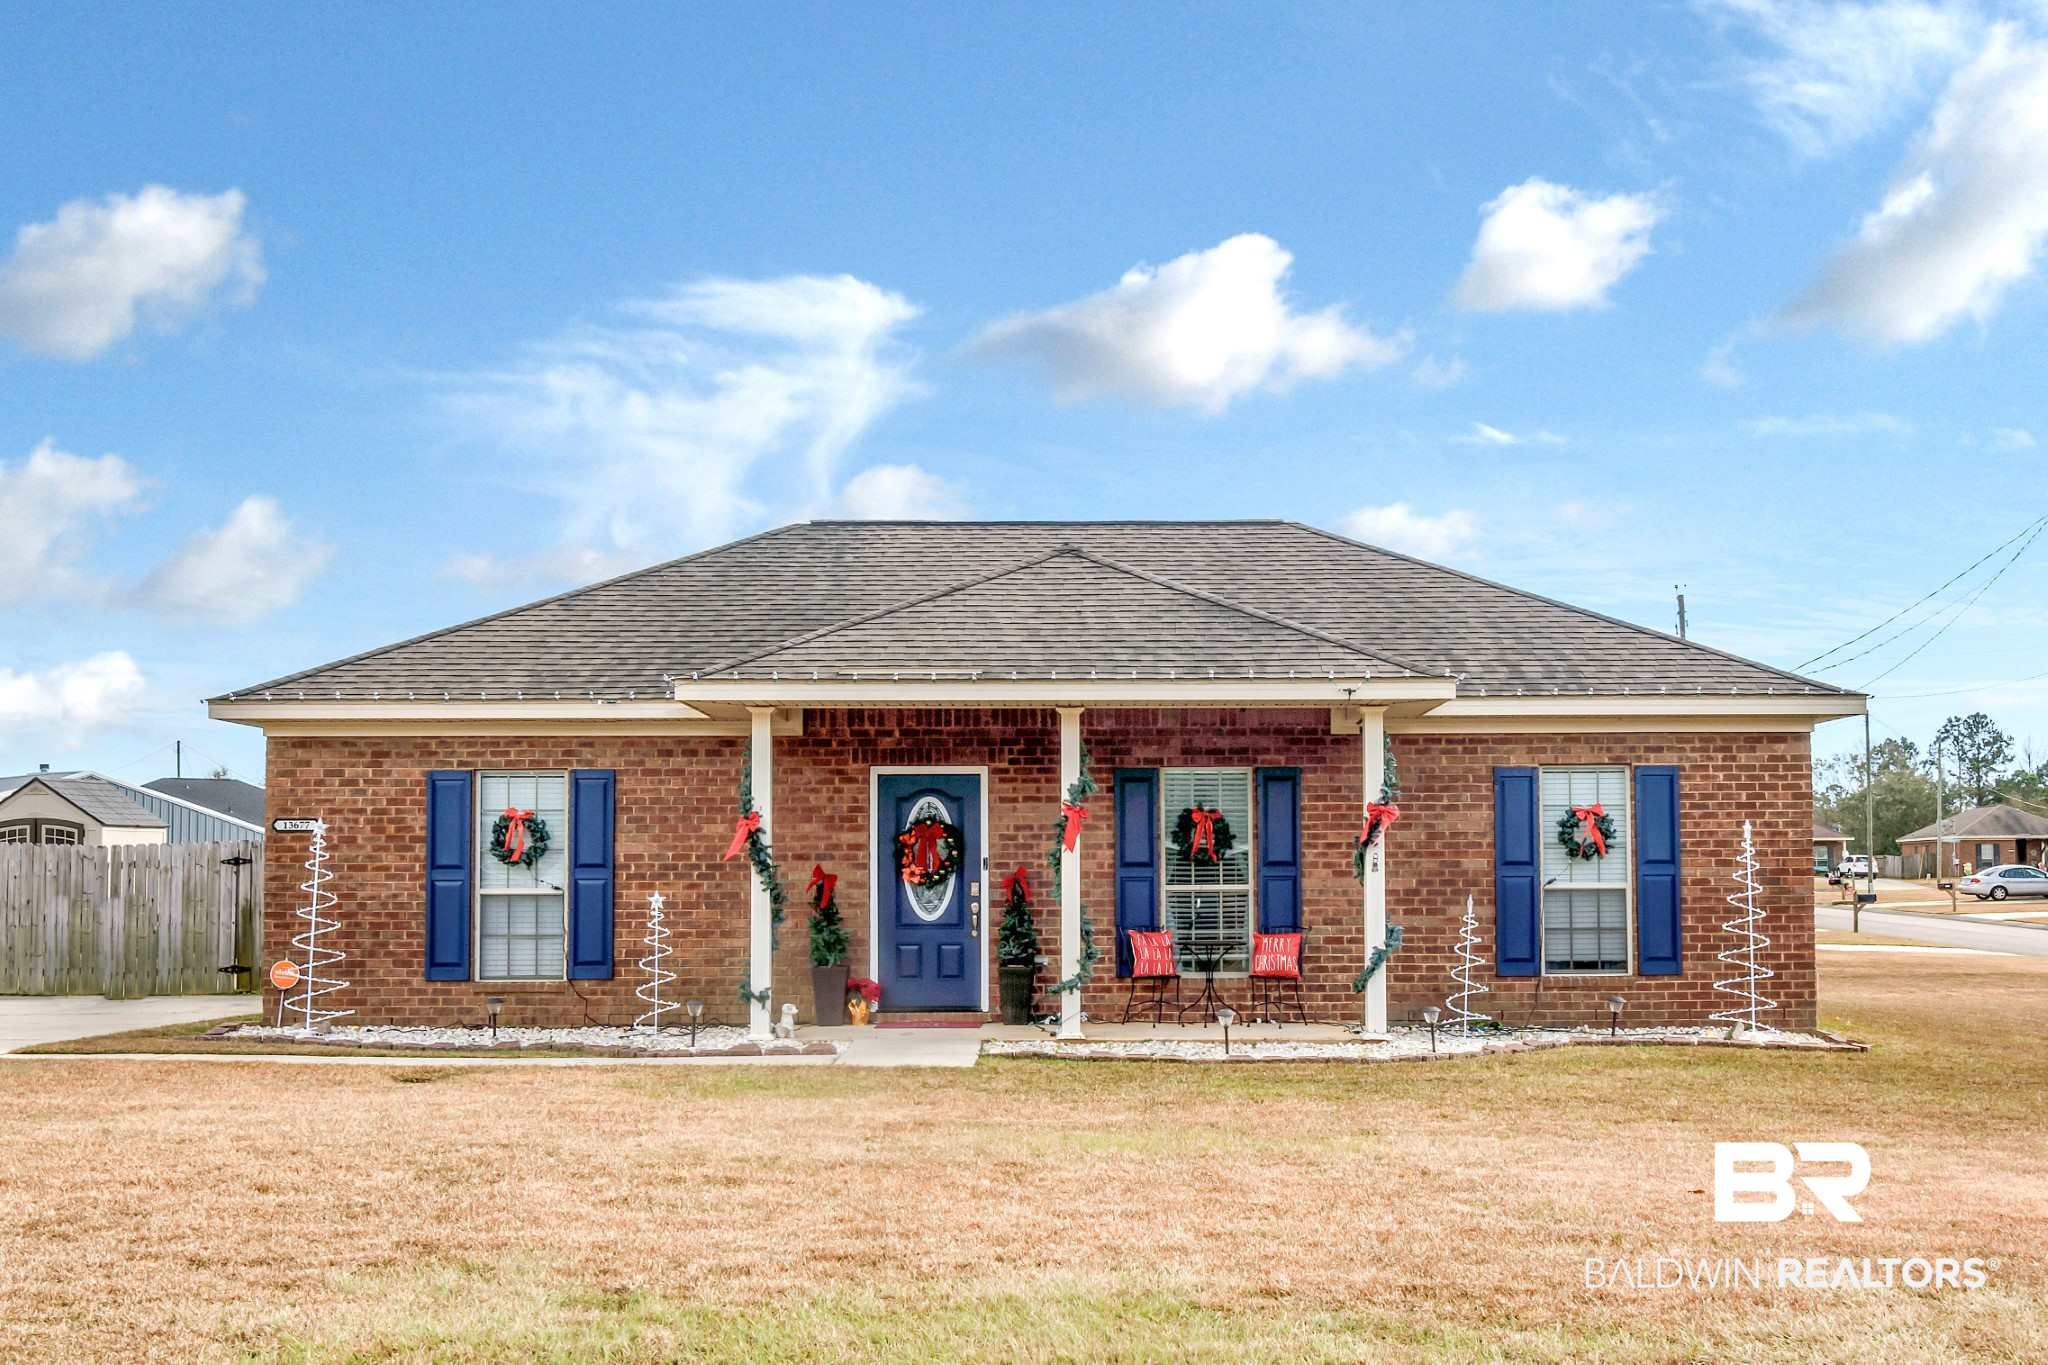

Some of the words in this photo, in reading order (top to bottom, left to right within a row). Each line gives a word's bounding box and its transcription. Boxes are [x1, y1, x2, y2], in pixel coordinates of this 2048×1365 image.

[283, 821, 310, 829] 13677
[1261, 936, 1292, 953] MERRY
[1255, 954, 1299, 972] CHRISTMAS
